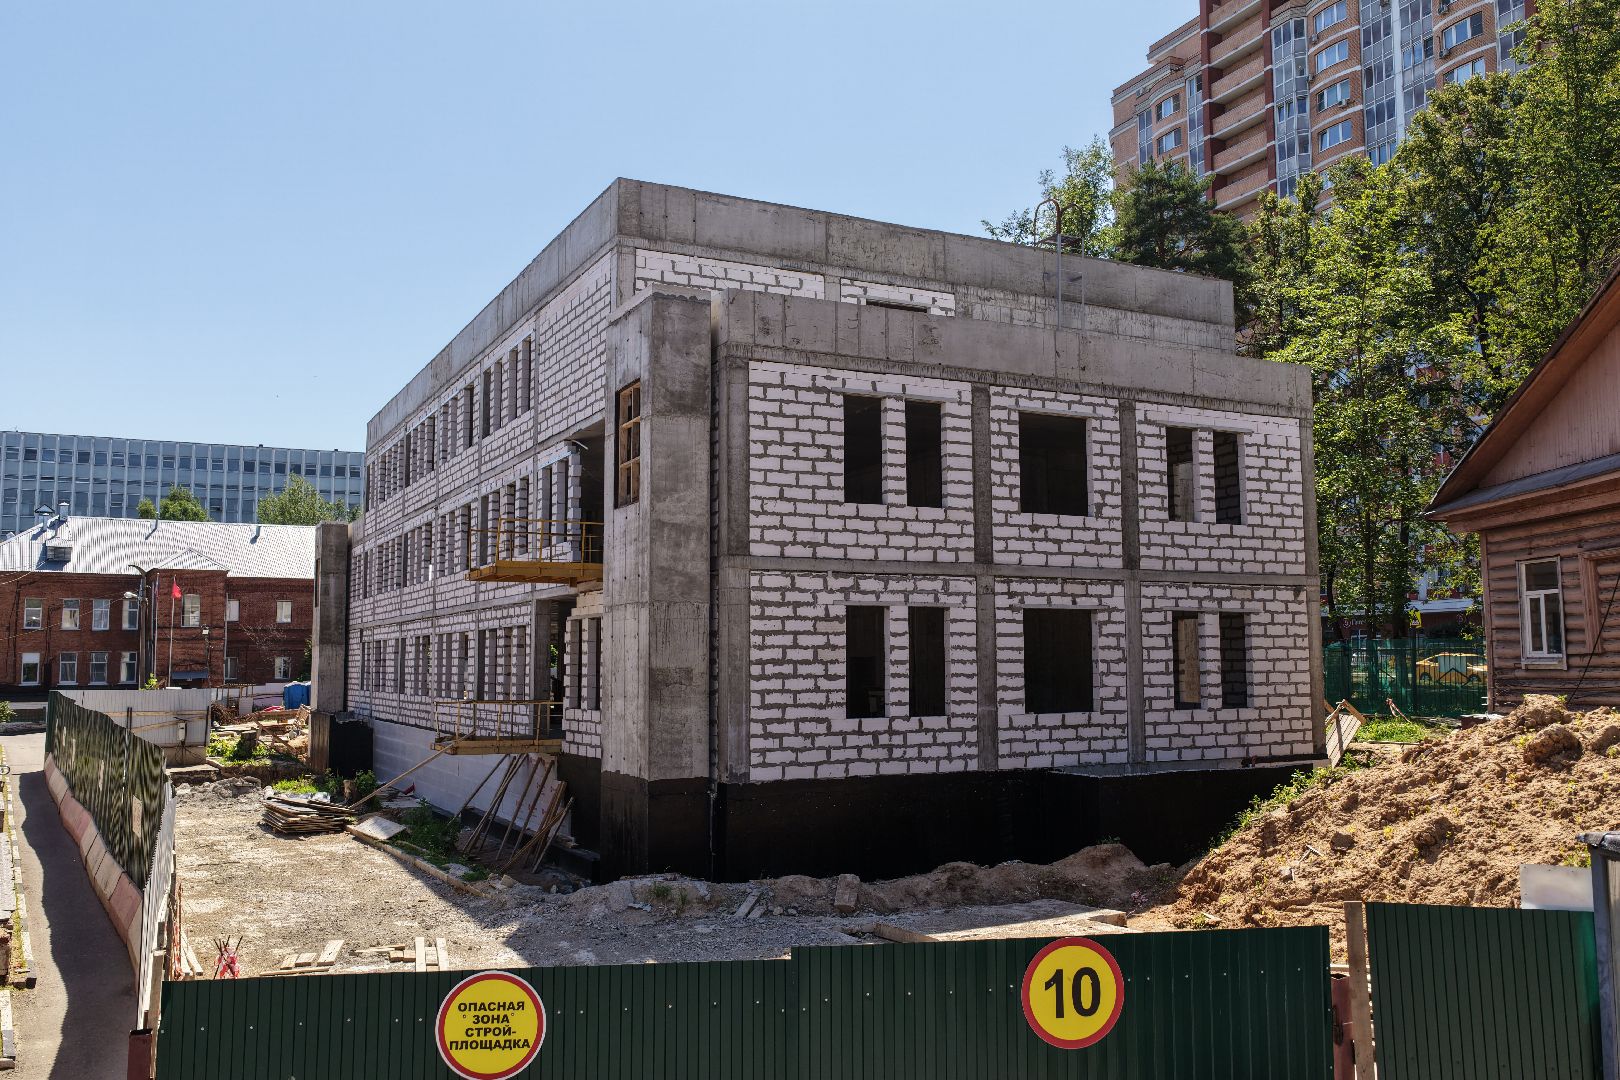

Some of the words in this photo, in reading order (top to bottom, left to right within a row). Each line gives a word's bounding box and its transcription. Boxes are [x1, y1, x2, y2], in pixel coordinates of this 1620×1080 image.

[1044, 966, 1101, 1019] 10
[457, 1001, 525, 1012] ОПАСНАЯ
[472, 1013, 510, 1024] ЗОНА
[465, 1024, 517, 1037] СТРОЙ-
[449, 1039, 531, 1051] ПЛОЩАДКА
